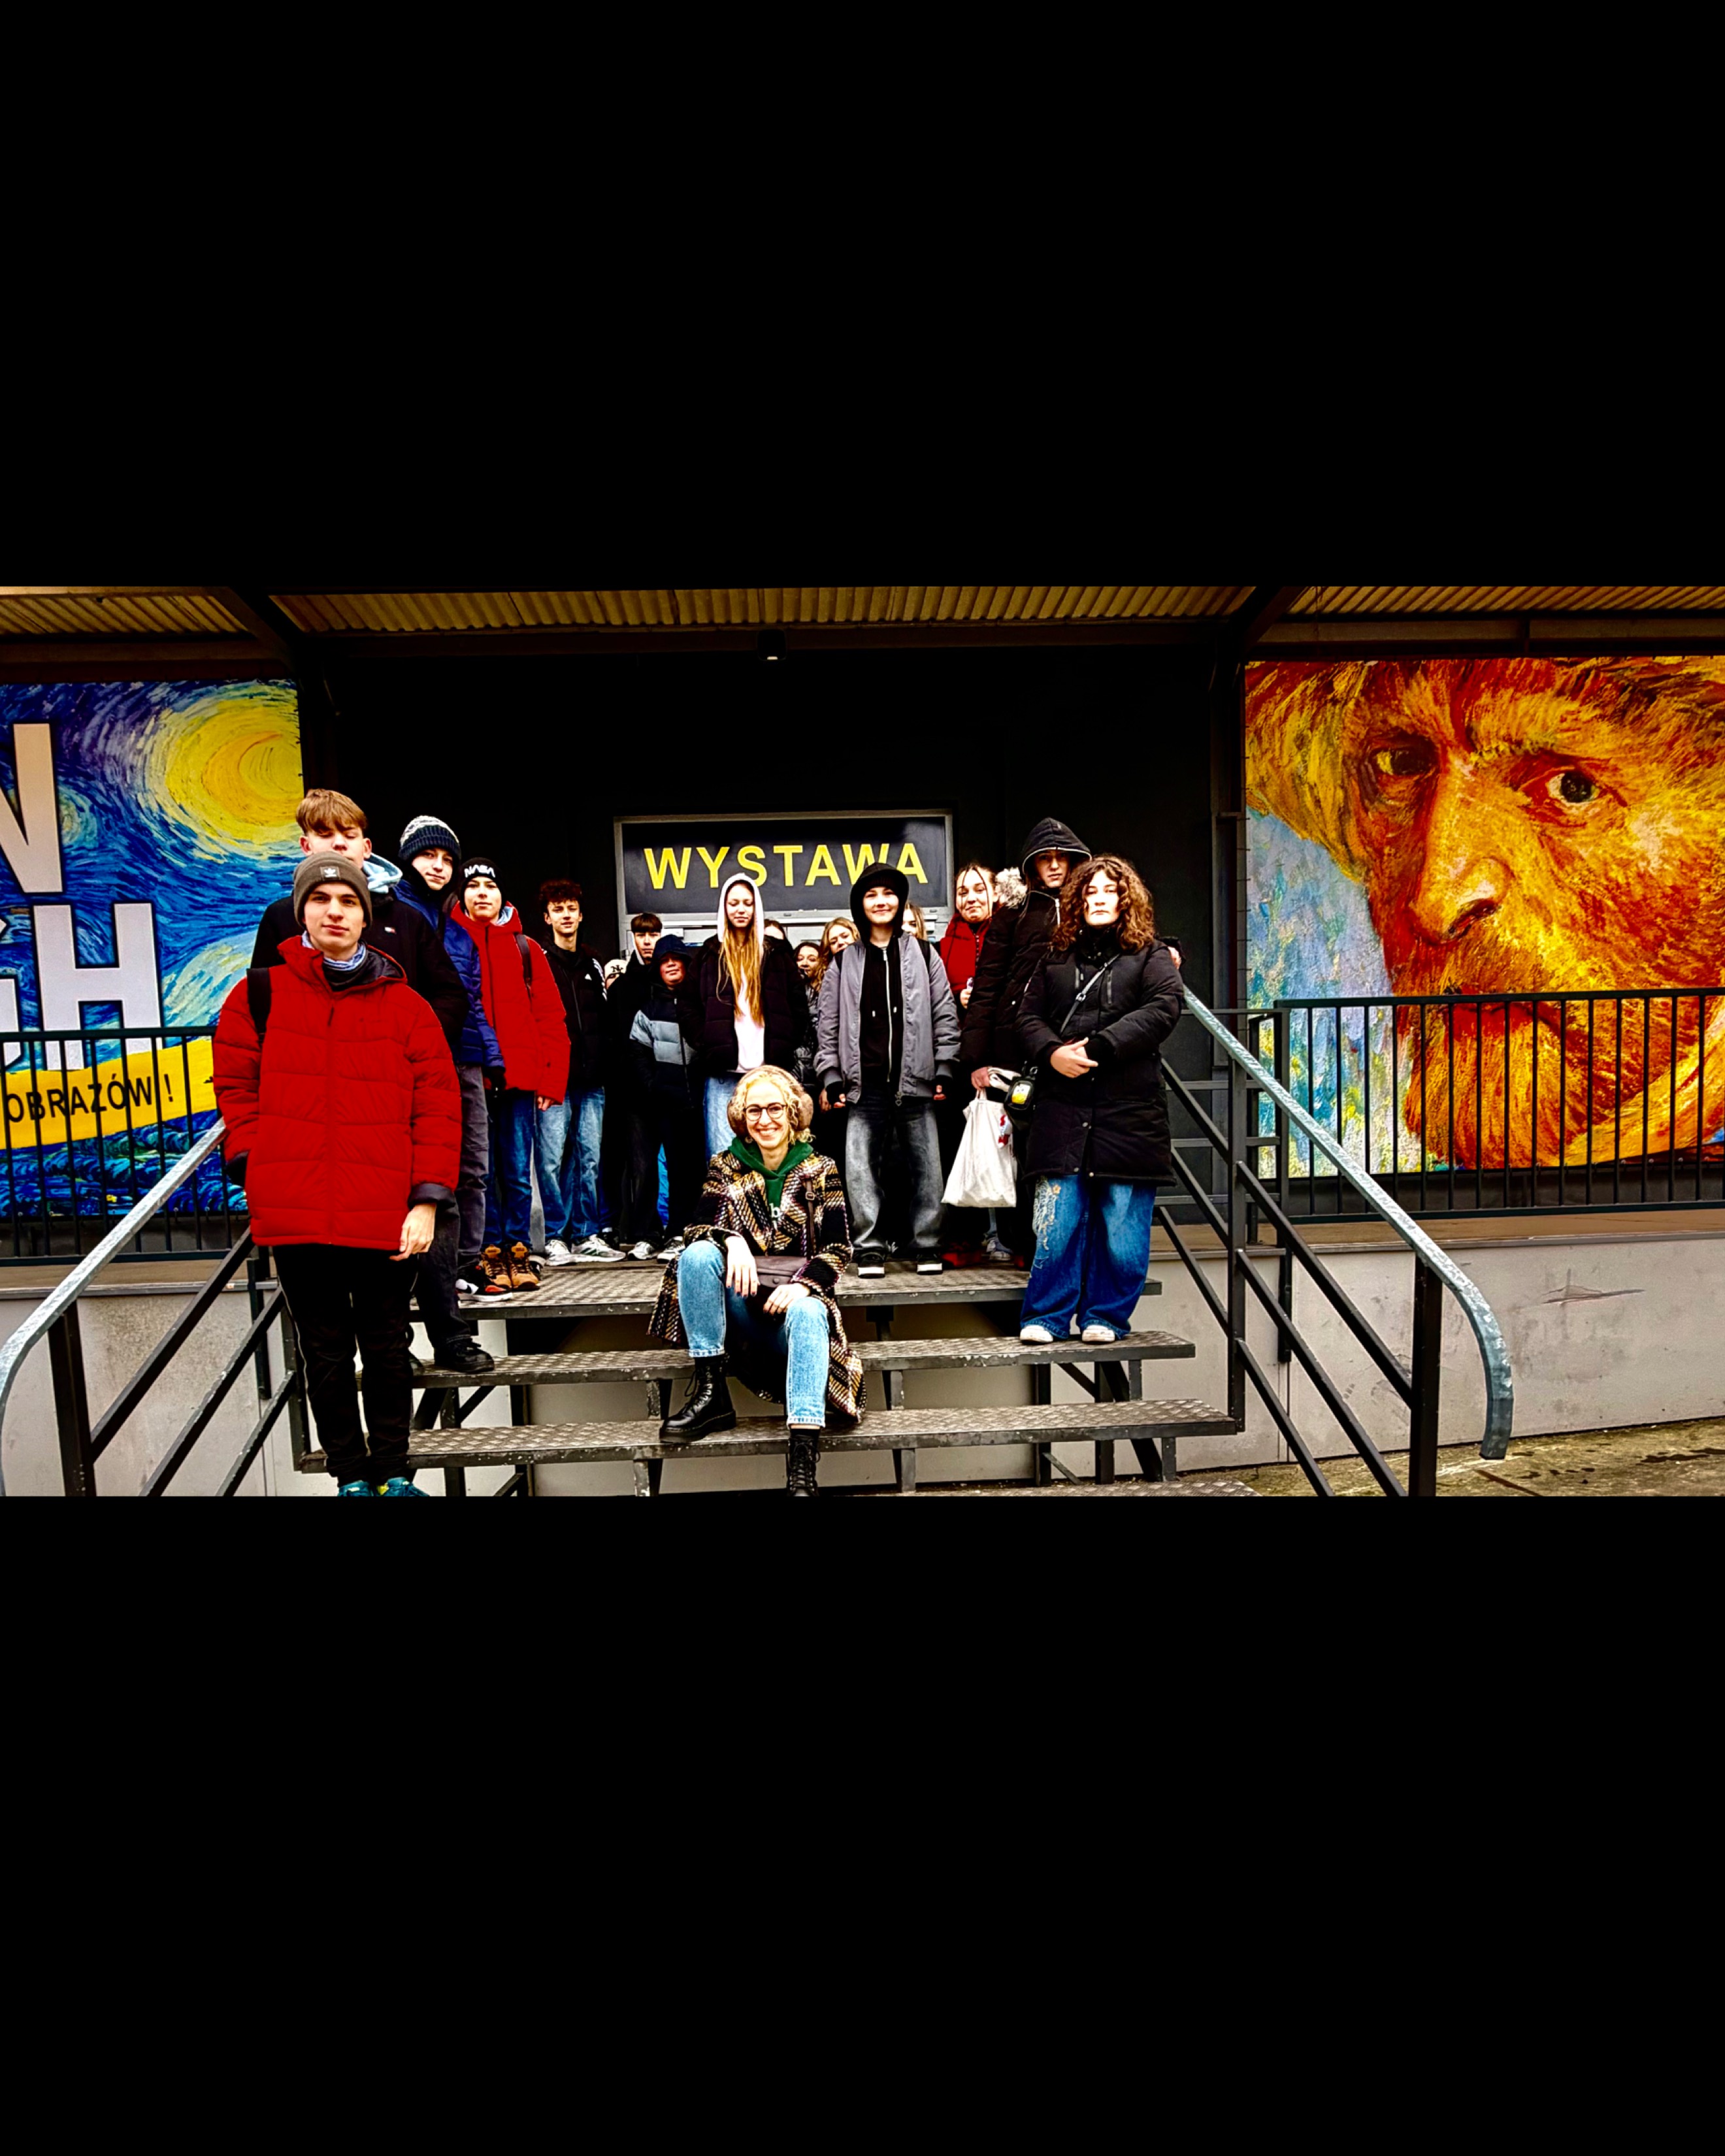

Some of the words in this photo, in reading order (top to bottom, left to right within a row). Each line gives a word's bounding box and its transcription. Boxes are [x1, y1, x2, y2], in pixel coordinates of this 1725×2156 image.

[464, 864, 496, 878] NASA
[644, 843, 928, 889] WYSTAWA
[5, 1073, 152, 1122] OBRAZÓW
